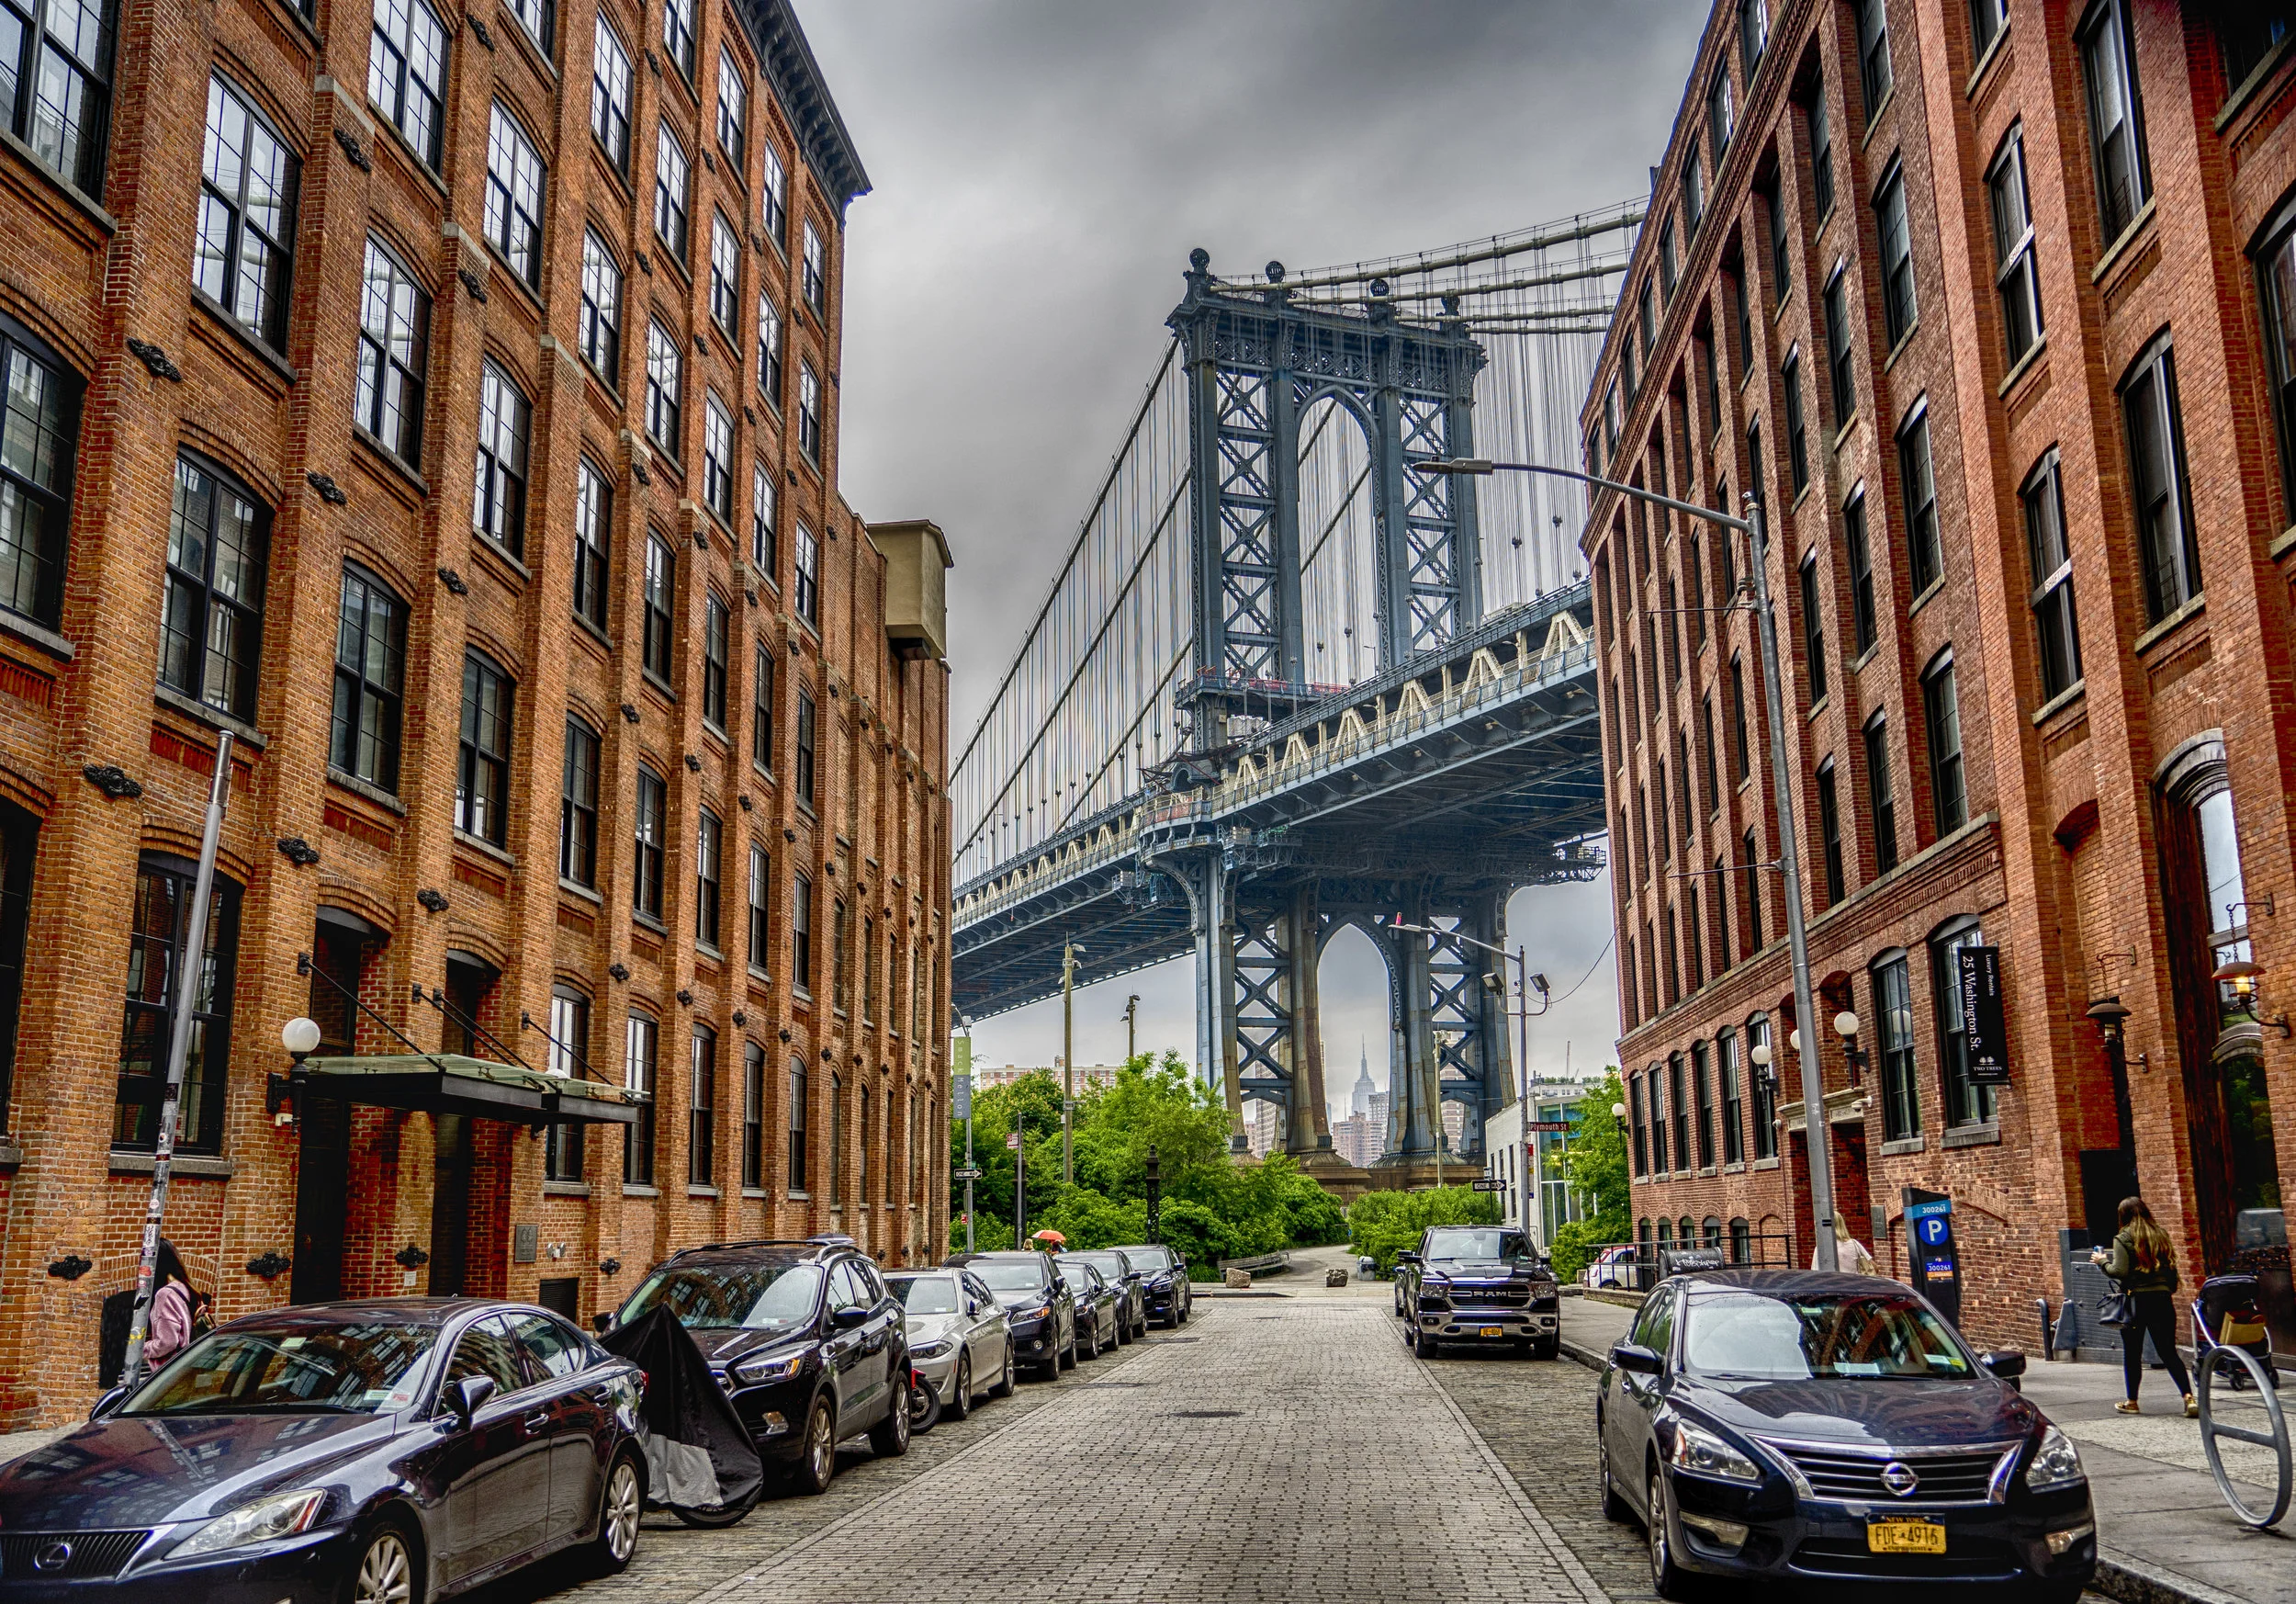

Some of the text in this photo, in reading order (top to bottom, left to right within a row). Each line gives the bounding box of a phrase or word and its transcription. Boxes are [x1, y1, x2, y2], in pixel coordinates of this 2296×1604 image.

[2044, 561, 2070, 587] SHAFTWAY
[1963, 955, 1981, 1051] 25 Washington St.
[1530, 1123, 1567, 1132] Plymouth St
[1922, 1205, 1946, 1214] 300261
[1928, 1220, 1942, 1242] P
